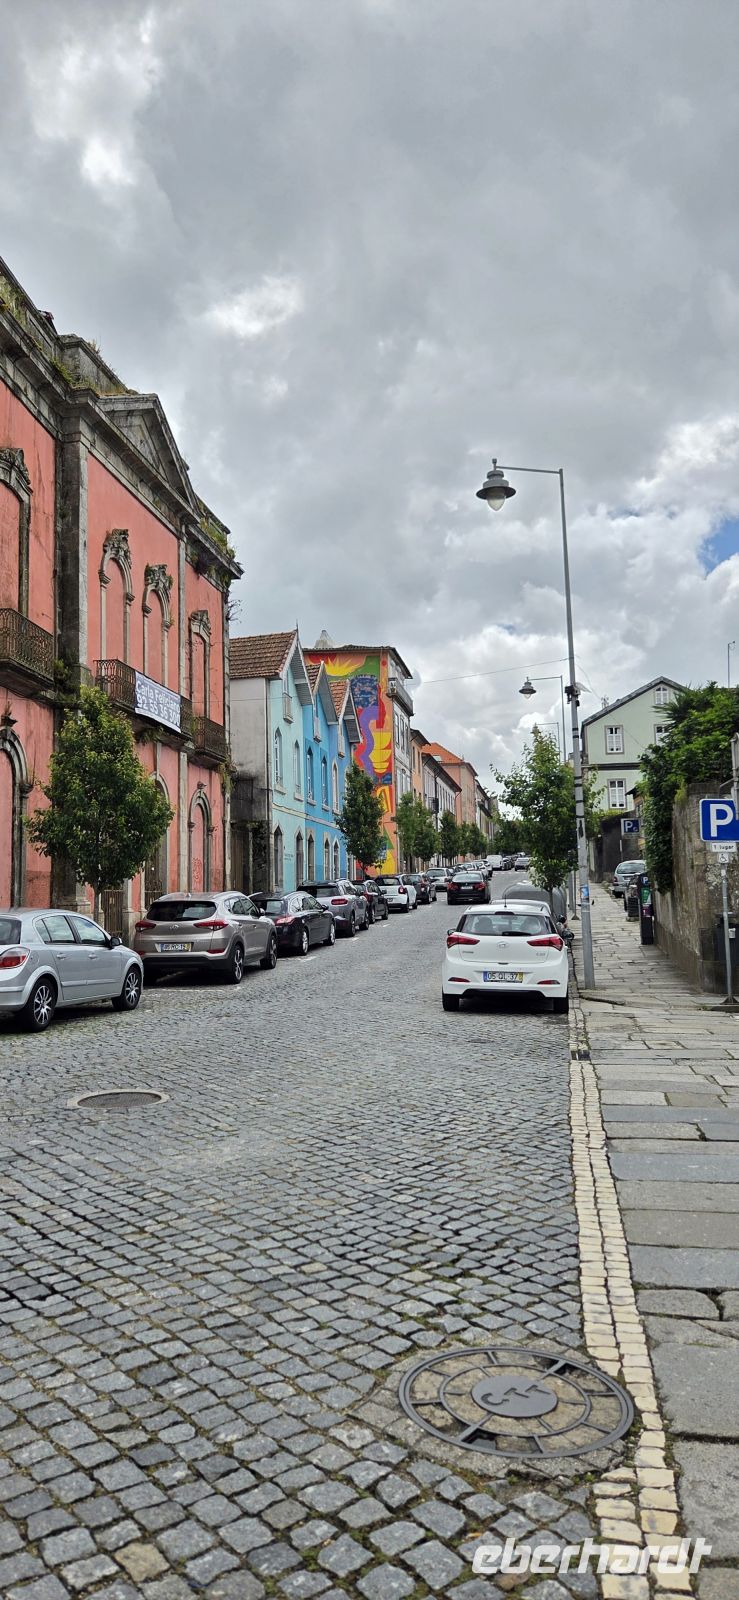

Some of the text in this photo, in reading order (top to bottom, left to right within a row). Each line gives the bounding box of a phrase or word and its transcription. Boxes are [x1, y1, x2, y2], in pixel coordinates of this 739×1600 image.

[136, 681, 180, 714] Carla Feliciano
[137, 694, 148, 710] 92
[625, 821, 633, 832] P
[709, 804, 734, 837] P
[480, 1384, 551, 1406] CTT
